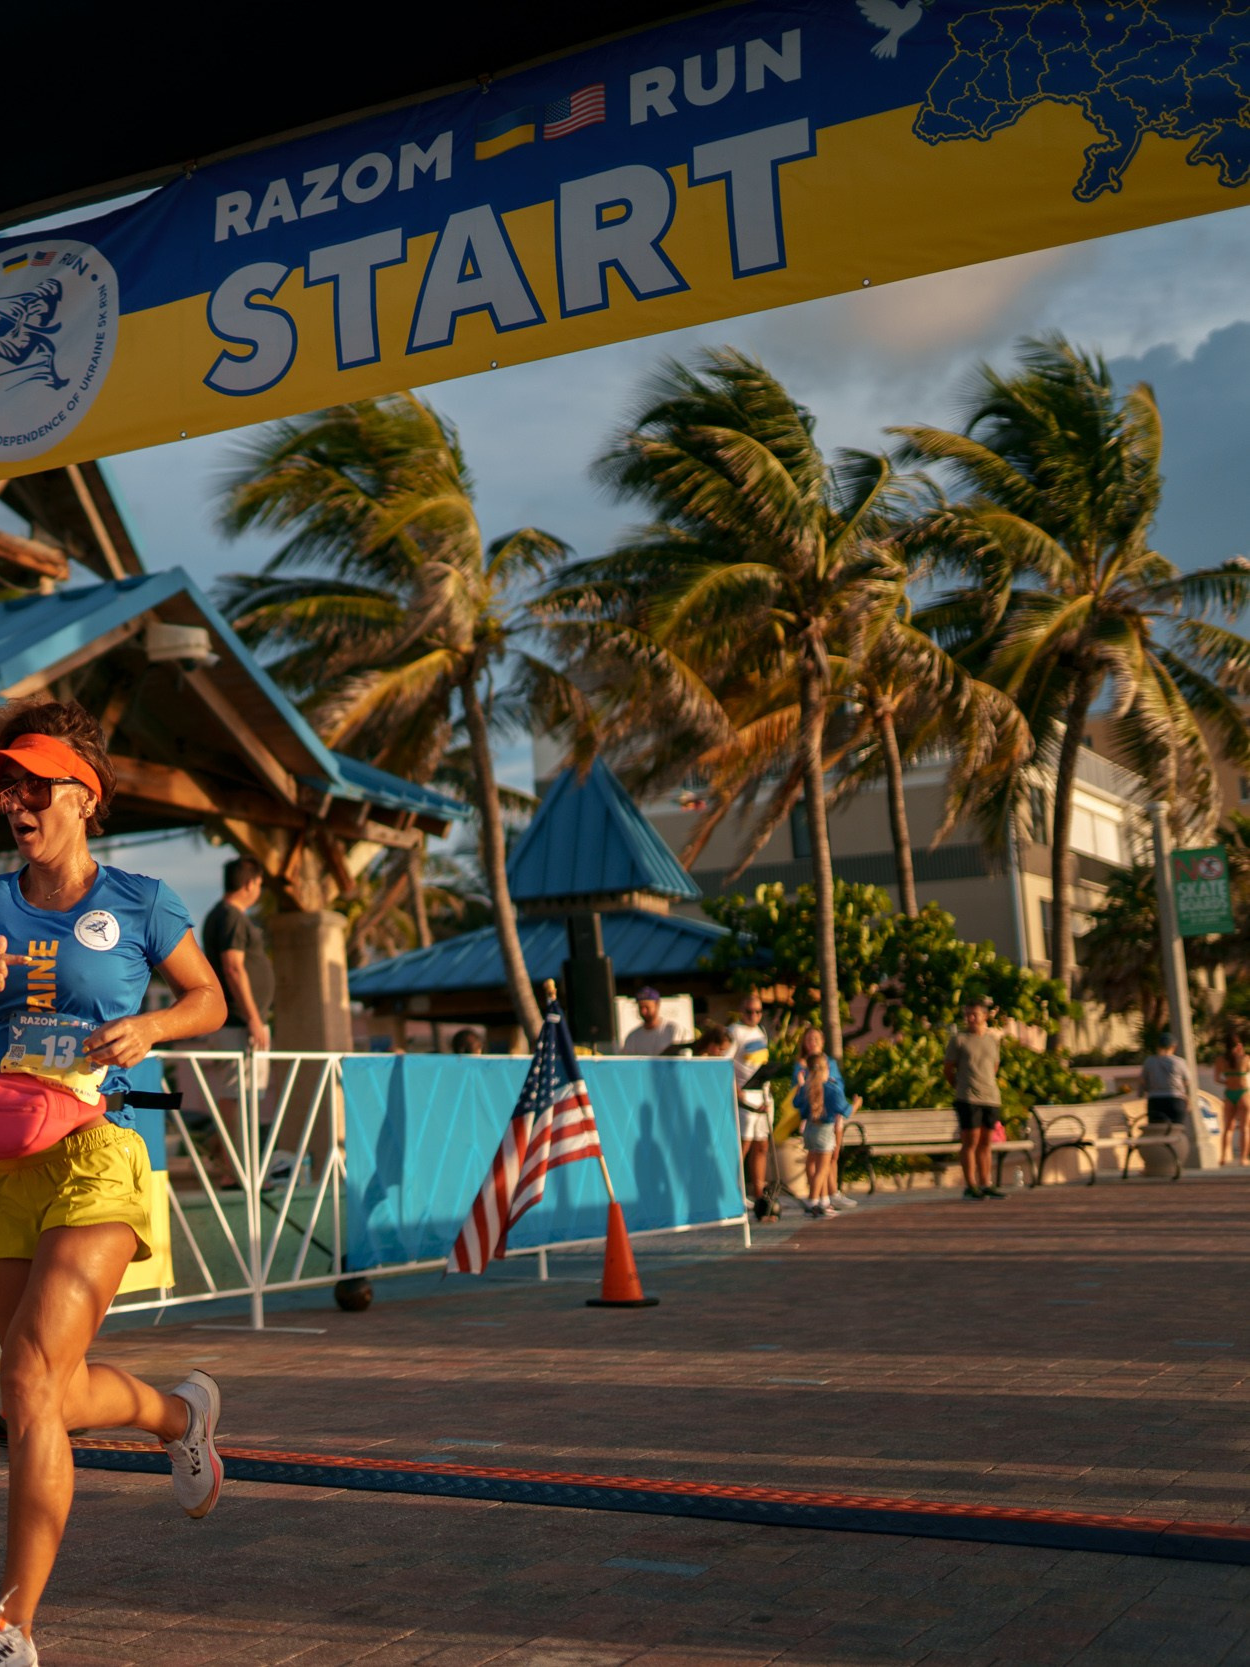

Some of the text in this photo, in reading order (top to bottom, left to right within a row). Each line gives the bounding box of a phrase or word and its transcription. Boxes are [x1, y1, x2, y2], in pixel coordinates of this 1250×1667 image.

[214, 28, 802, 243] RAZOM RUN
[58, 252, 90, 277] RUN
[203, 118, 817, 397] START
[97, 284, 109, 309] RUN
[97, 311, 108, 328] 5K
[79, 331, 106, 391] UKRAINE
[66, 391, 81, 412] OF
[1176, 880, 1228, 898] SKATE
[20, 1015, 58, 1027] RAZOM
[41, 1034, 77, 1070] 13
